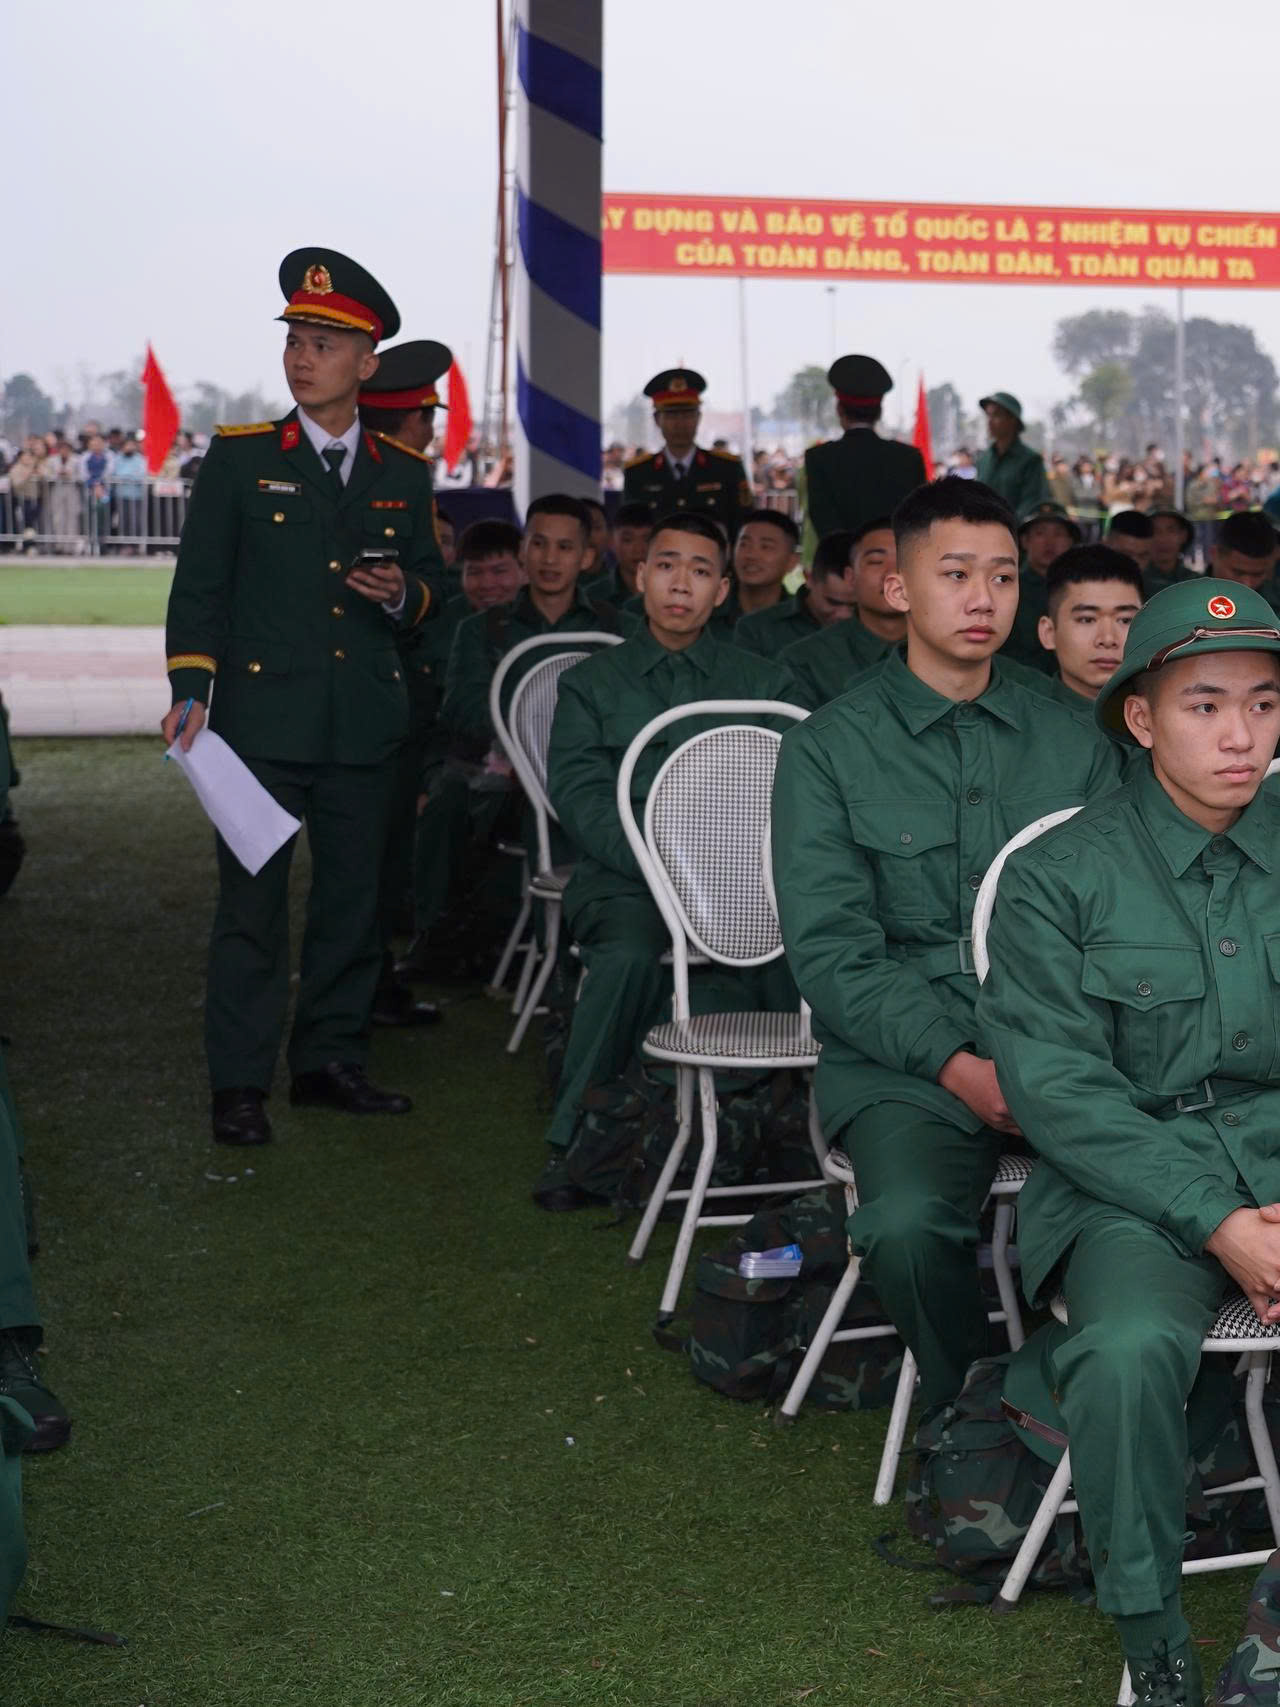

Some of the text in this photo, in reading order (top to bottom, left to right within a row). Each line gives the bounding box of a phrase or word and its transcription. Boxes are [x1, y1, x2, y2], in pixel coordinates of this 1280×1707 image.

[634, 207, 714, 235] DỰNG
[721, 207, 758, 233] VÀ
[766, 207, 824, 235] BẢO
[831, 211, 866, 241] VỆ
[874, 209, 907, 238] TỐ
[914, 212, 990, 241] QUỐC
[996, 217, 1030, 242] LÀ
[1036, 221, 1055, 243] 2
[1061, 219, 1149, 248] NHIỆM
[1155, 224, 1192, 250] VỤ
[1197, 220, 1277, 249] CHIẾN
[676, 238, 734, 266] CỦA
[742, 241, 817, 268] TOÀN
[917, 247, 990, 274] TOÀN
[1069, 252, 1139, 278] TOÀN
[1145, 254, 1219, 280] QUÂN
[1226, 257, 1255, 280] TA
